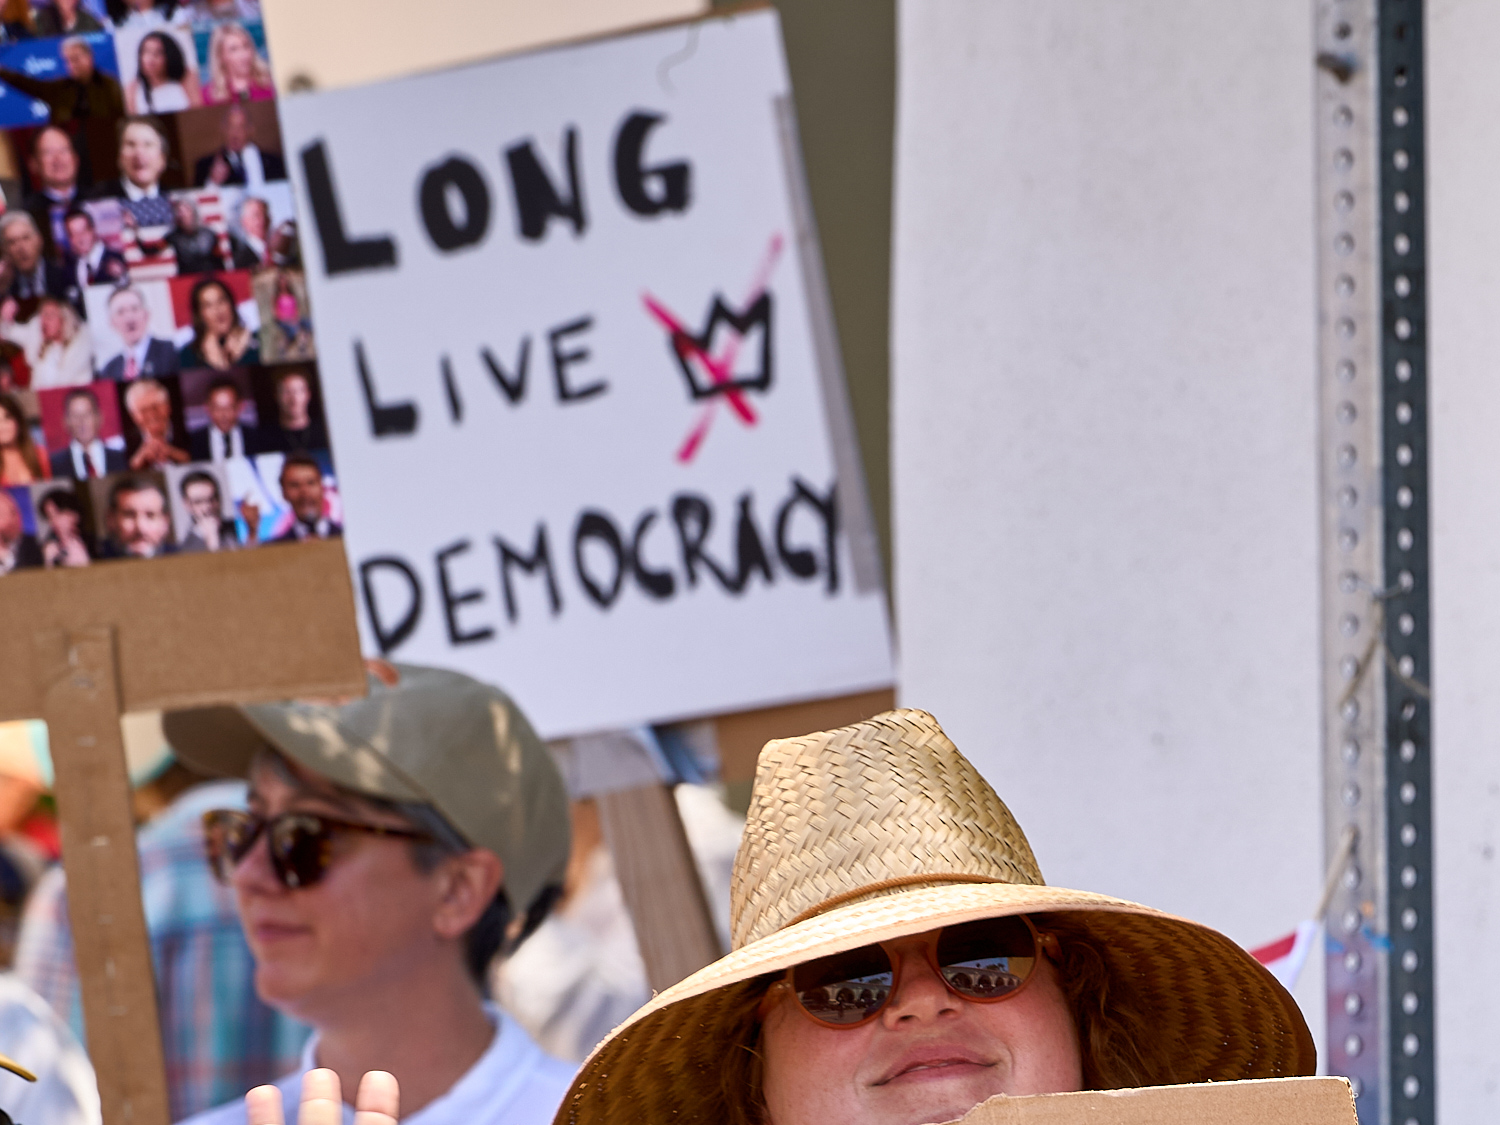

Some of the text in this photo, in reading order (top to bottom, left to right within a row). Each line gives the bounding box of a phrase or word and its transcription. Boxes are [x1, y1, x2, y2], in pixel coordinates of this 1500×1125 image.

[300, 108, 692, 277] LONG
[352, 316, 608, 440] LIVE
[359, 477, 843, 656] DEMOCRACY
